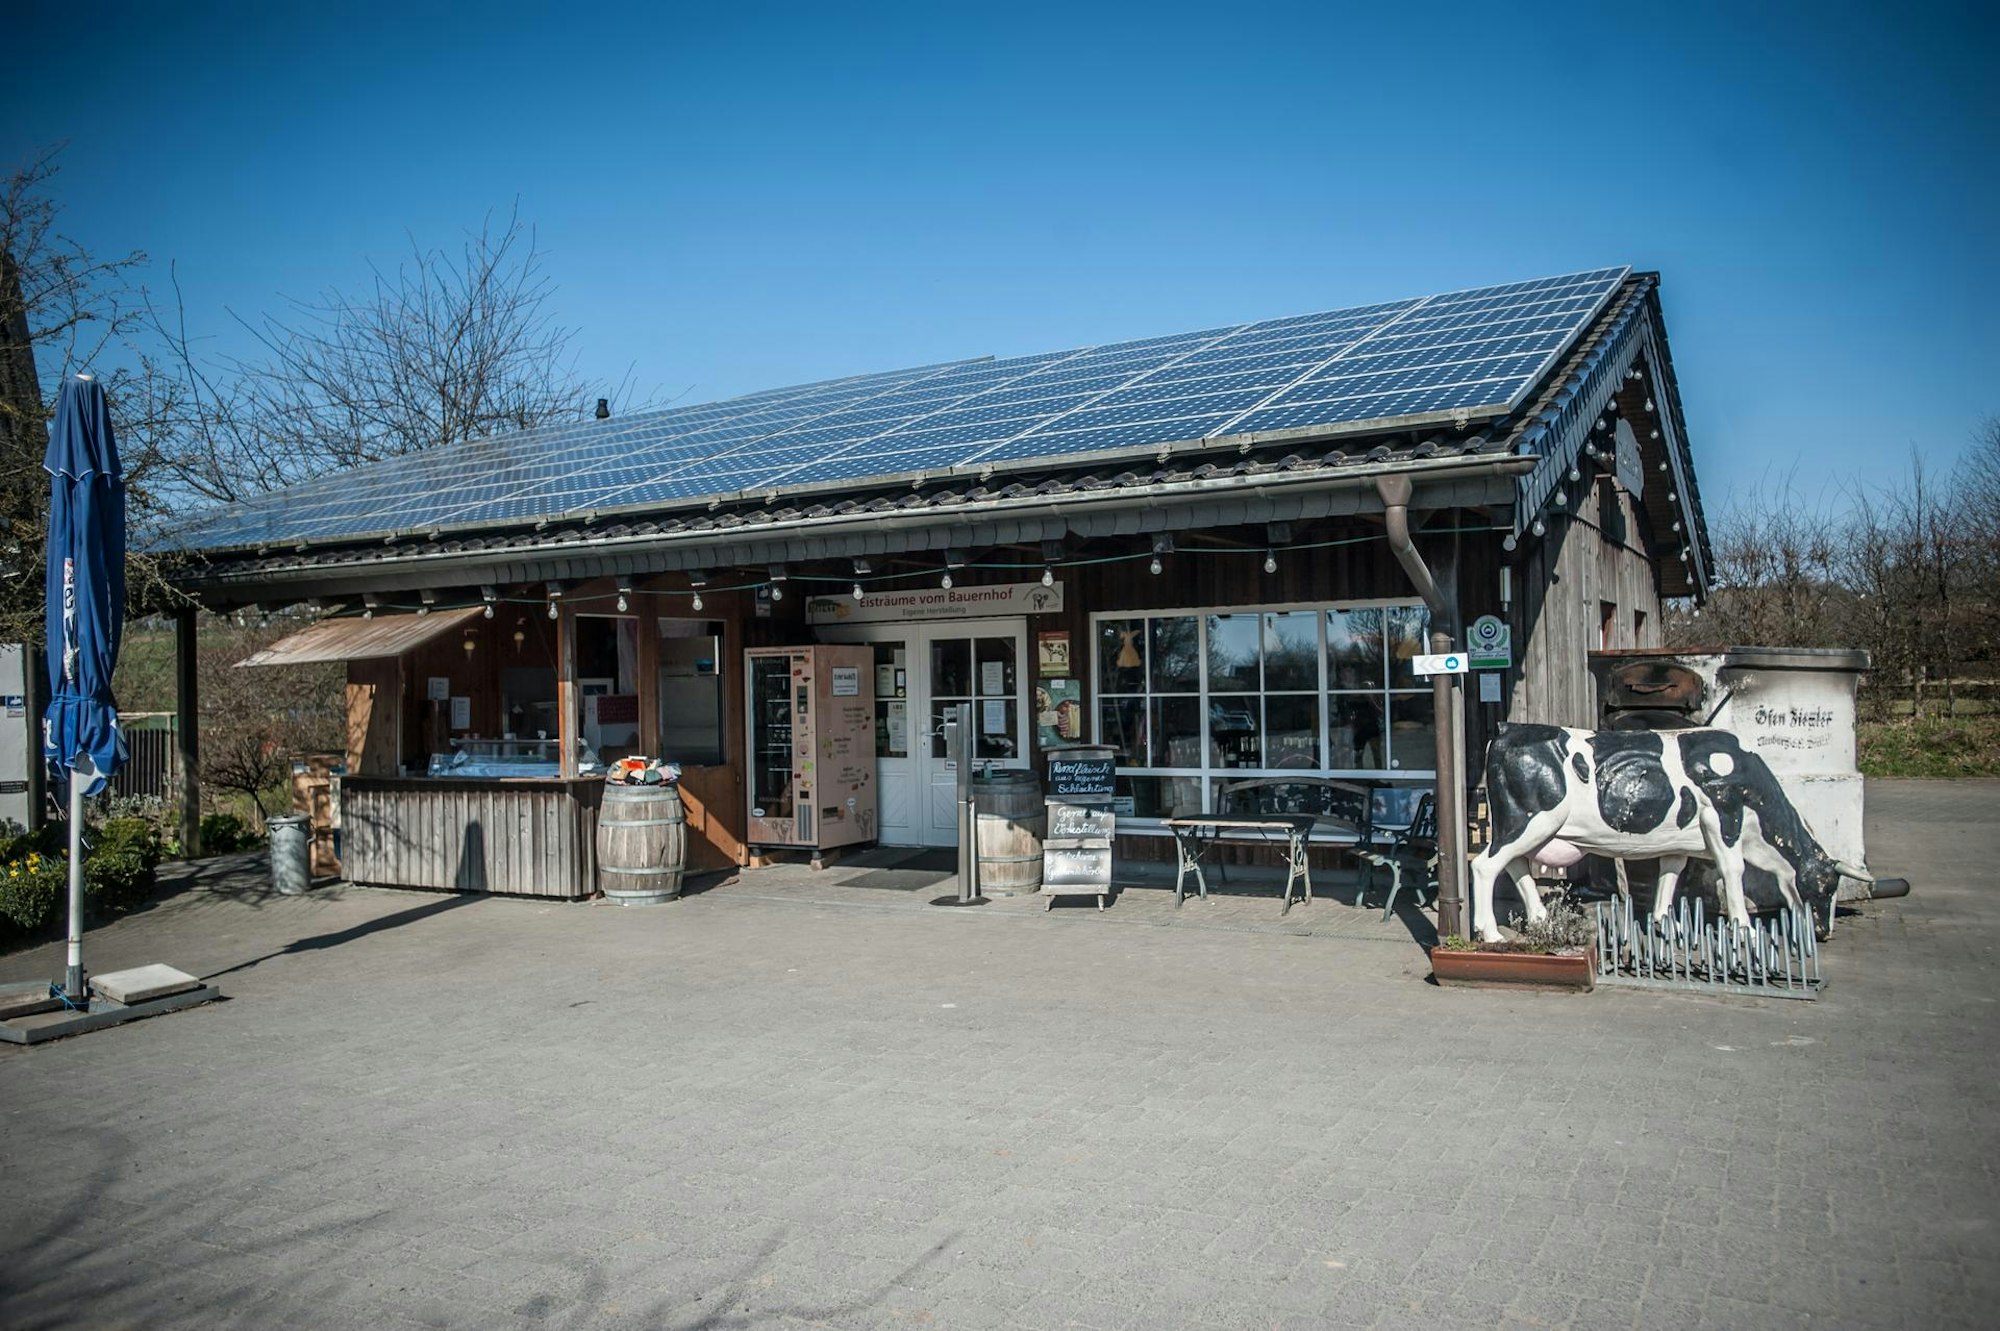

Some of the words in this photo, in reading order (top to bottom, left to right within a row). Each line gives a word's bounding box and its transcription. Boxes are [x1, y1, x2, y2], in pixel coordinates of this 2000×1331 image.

[859, 594, 916, 608] Eisträume
[919, 594, 945, 604] vom
[948, 588, 1013, 602] Bauernhof
[902, 608, 925, 617] Eigene
[926, 605, 967, 615] Herstellung
[1053, 761, 1110, 776] Rindfleisch
